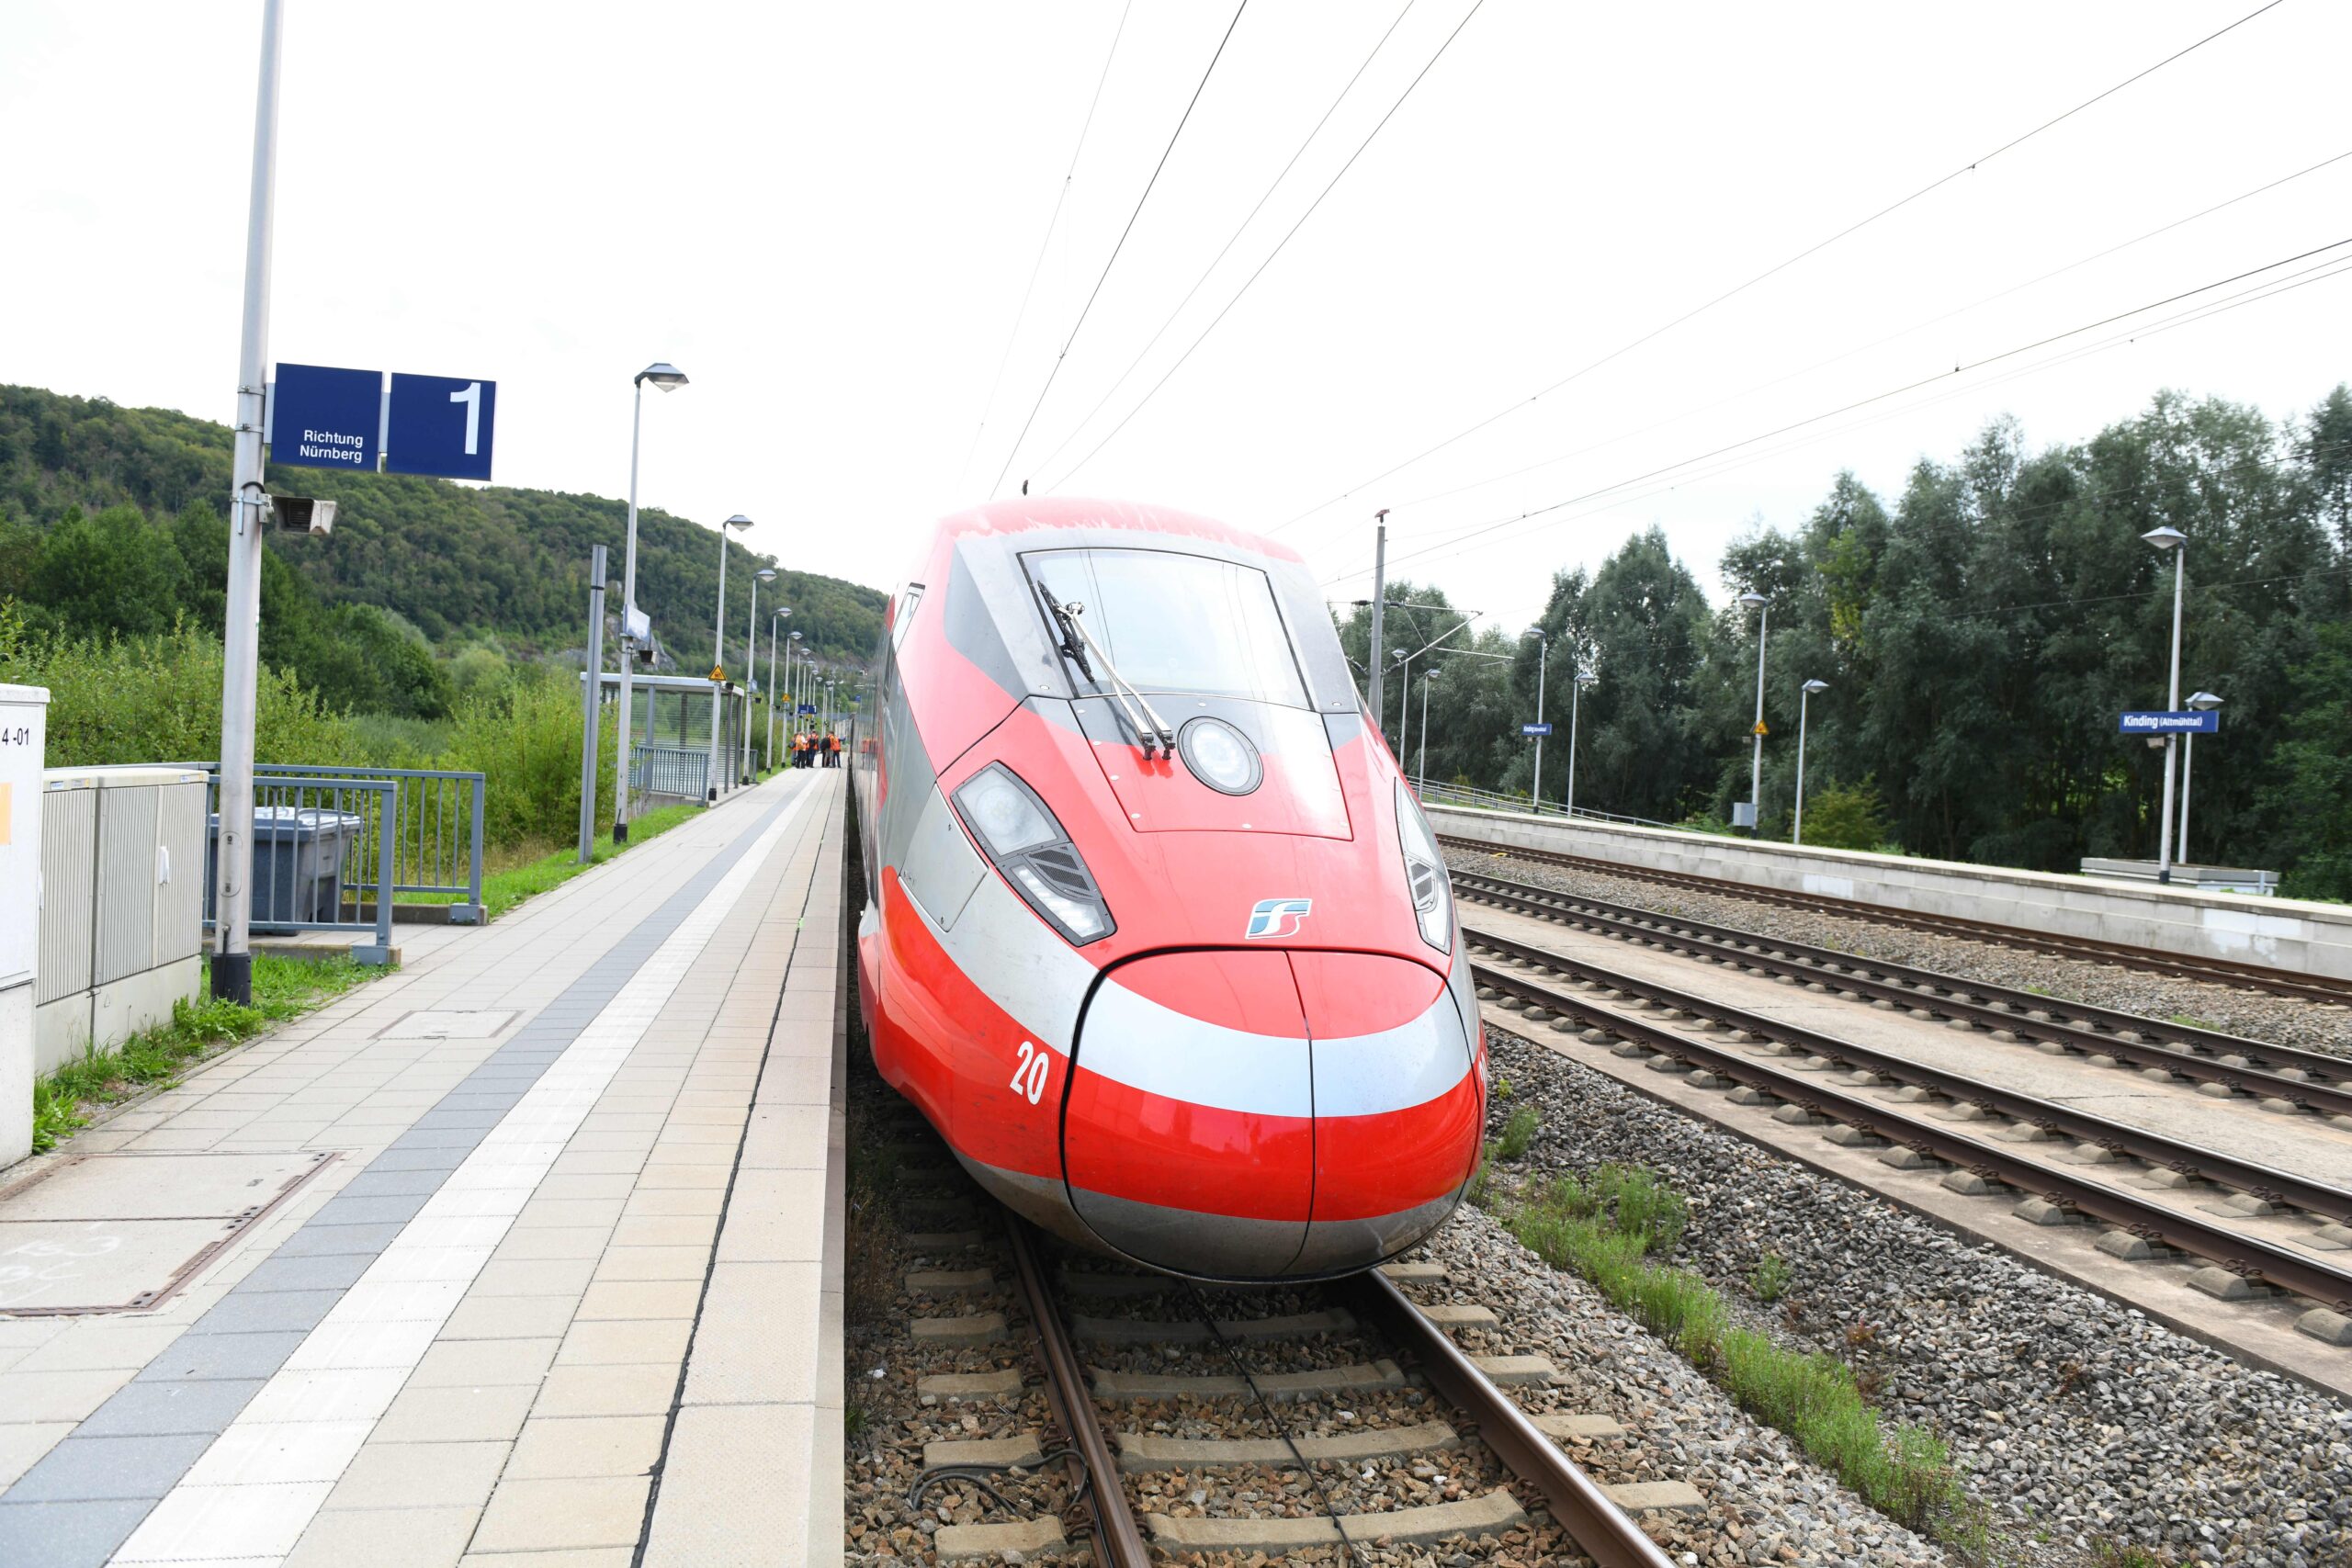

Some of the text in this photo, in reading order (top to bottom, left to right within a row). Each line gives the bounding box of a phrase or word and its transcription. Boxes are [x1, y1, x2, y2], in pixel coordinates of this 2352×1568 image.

[449, 381, 481, 455] 1
[303, 429, 364, 448] Richtung
[299, 445, 363, 464] Nürnberg
[2123, 715, 2203, 729] Kinding (Altmühltal)
[1010, 1041, 1049, 1105] 20
